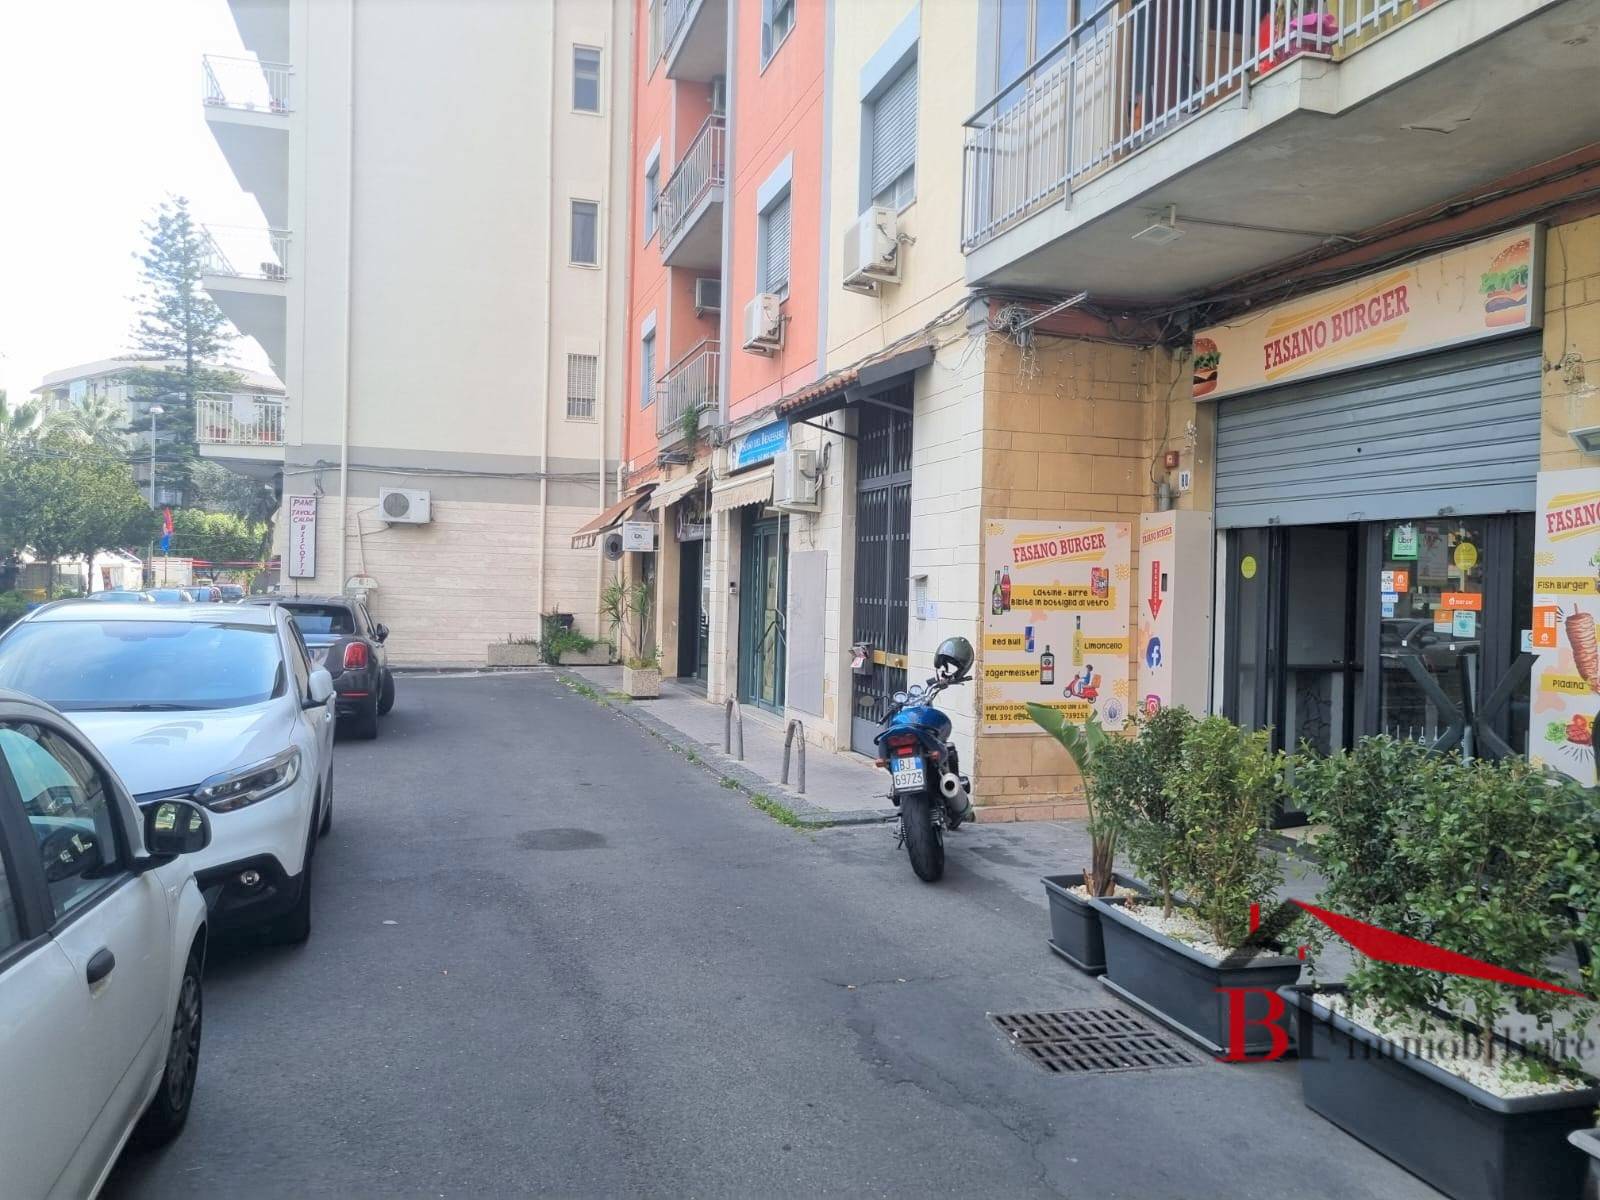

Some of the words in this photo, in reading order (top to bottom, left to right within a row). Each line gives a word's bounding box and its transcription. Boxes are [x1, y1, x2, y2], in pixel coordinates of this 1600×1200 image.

[1264, 320, 1328, 371] FASANO
[1331, 286, 1409, 342] BURGER
[293, 499, 315, 507] PANE
[1012, 540, 1058, 563] FASANO
[1060, 533, 1107, 556] BURGER
[1537, 580, 1555, 590] Fish
[1557, 580, 1590, 592] Burger
[992, 637, 1005, 646] Red
[1007, 638, 1021, 646] Bull
[1084, 641, 1122, 649] Limoncello
[1552, 679, 1585, 690] Piadina
[896, 772, 922, 785] 69723
